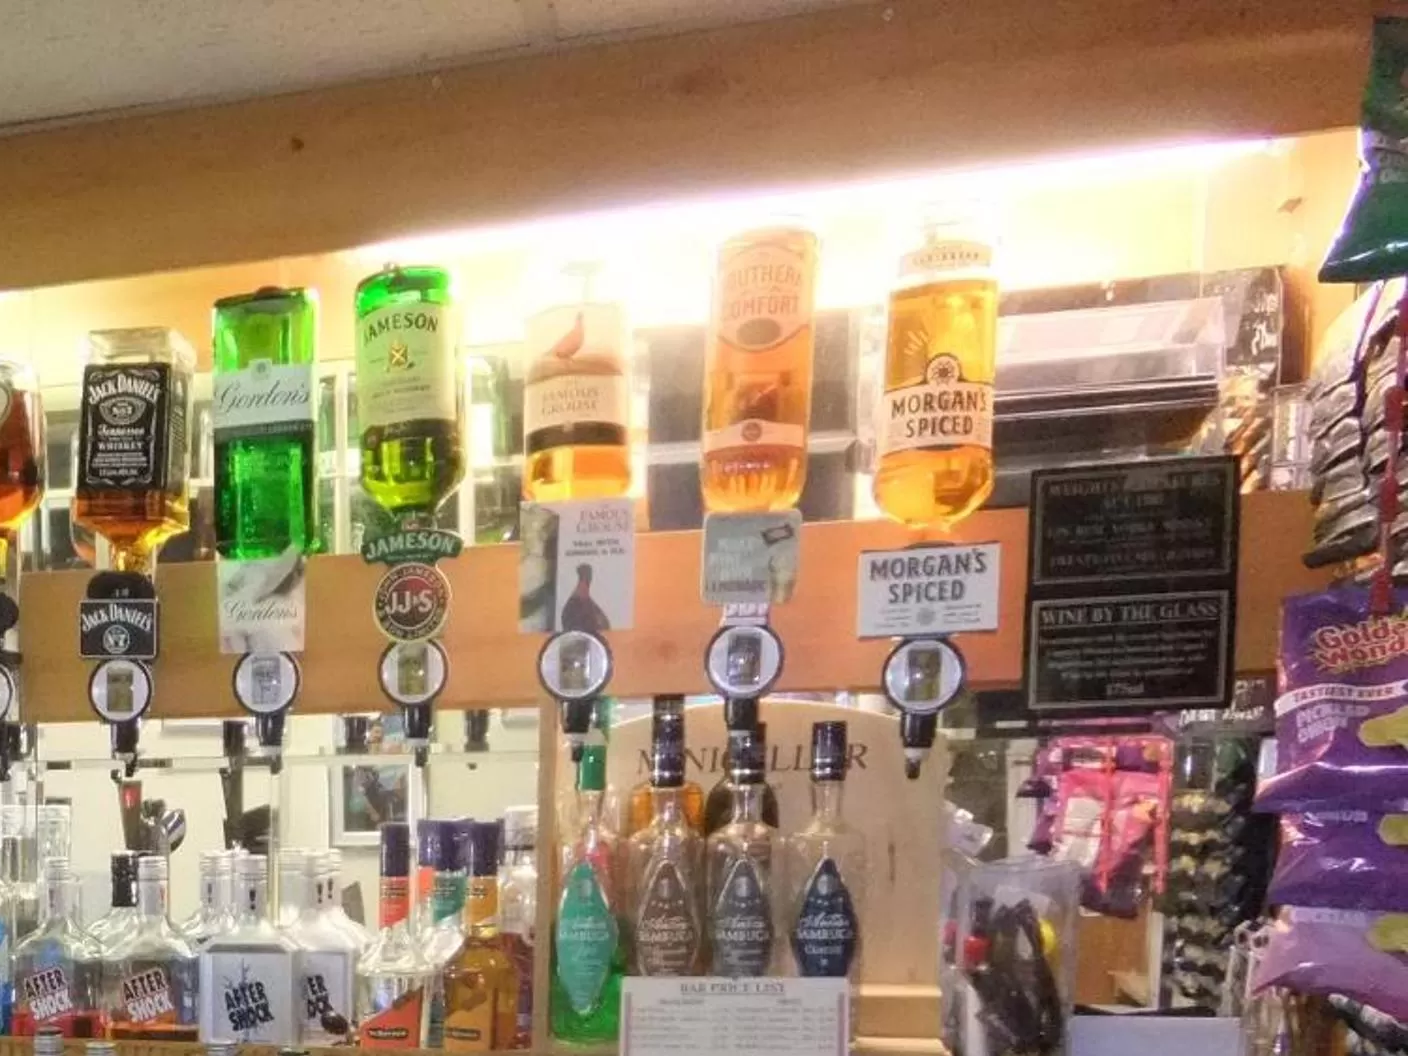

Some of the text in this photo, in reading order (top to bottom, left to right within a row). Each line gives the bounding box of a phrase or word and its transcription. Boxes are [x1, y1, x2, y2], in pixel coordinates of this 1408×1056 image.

[363, 311, 439, 347] JAMESON
[87, 373, 161, 405] JACK DANIEL'S
[214, 379, 311, 415] Gordon's
[891, 387, 988, 422] MORGAN'S
[904, 415, 974, 439] SPICED
[366, 531, 455, 560] JAMESON
[869, 548, 988, 582] MORGAN'S
[887, 578, 967, 604] SPICED
[81, 602, 153, 633] JACK DANIEL'S
[1041, 600, 1220, 625] WINE BY THE GLASS
[1317, 620, 1408, 650] Golde
[1322, 636, 1406, 668] Wond
[23, 966, 68, 999] AFTER
[121, 967, 167, 1003] AFTER
[223, 980, 267, 1010] AFTER
[679, 983, 786, 994] BAR PRICE LIST
[28, 989, 74, 1020] SHOCK
[127, 993, 175, 1023] SHOCK
[228, 1002, 275, 1032] SHOCK
